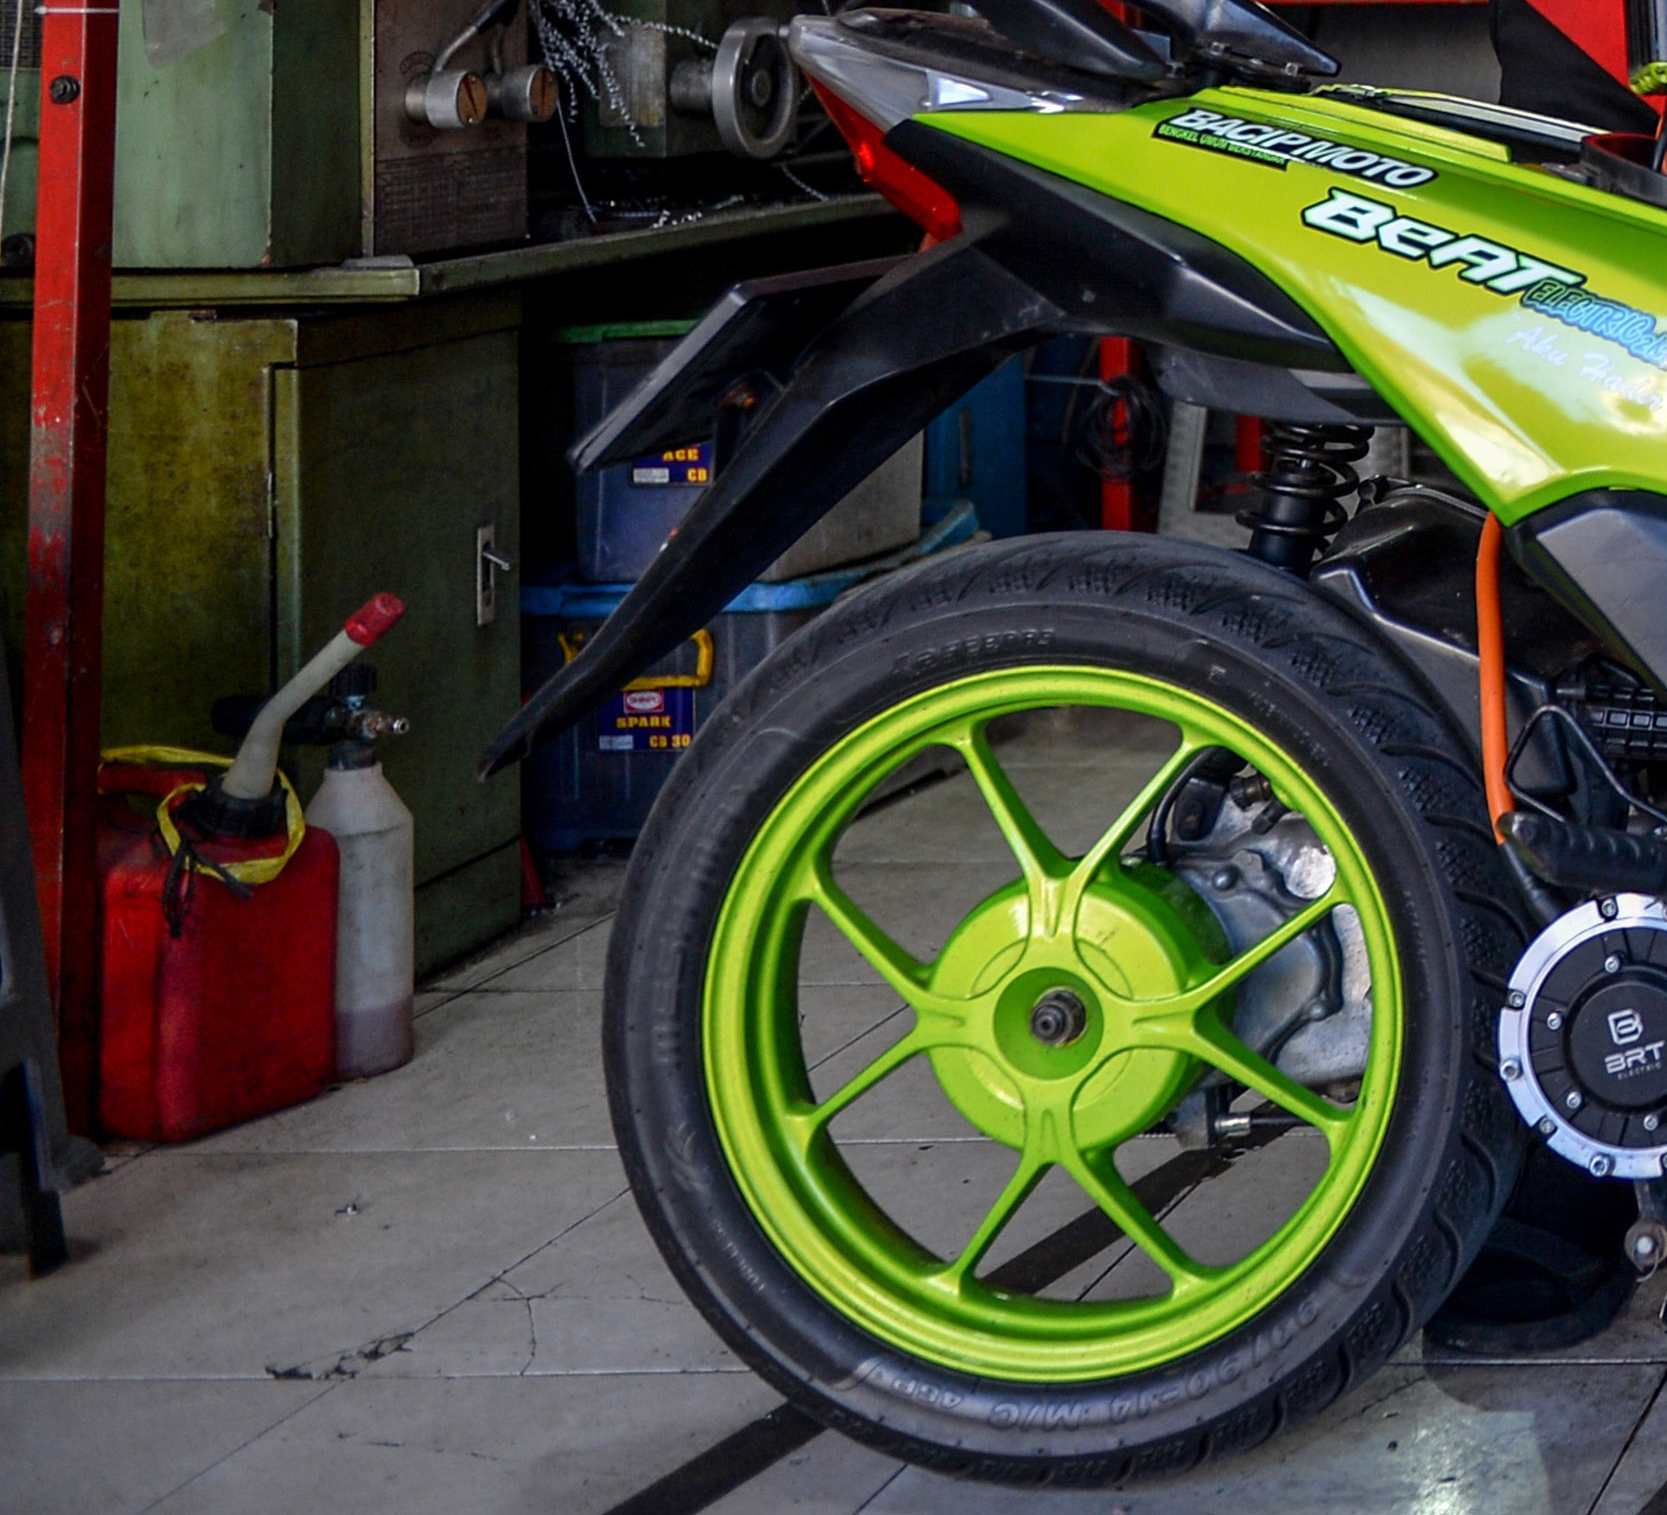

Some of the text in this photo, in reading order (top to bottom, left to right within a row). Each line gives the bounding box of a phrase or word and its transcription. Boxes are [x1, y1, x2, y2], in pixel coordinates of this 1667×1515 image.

[1168, 108, 1436, 186] BACIP MOTO
[1521, 281, 1657, 345] ELECTRIC
[615, 715, 672, 729] SPARK
[648, 733, 692, 749] CB 30
[1603, 1040, 1665, 1074] BRT
